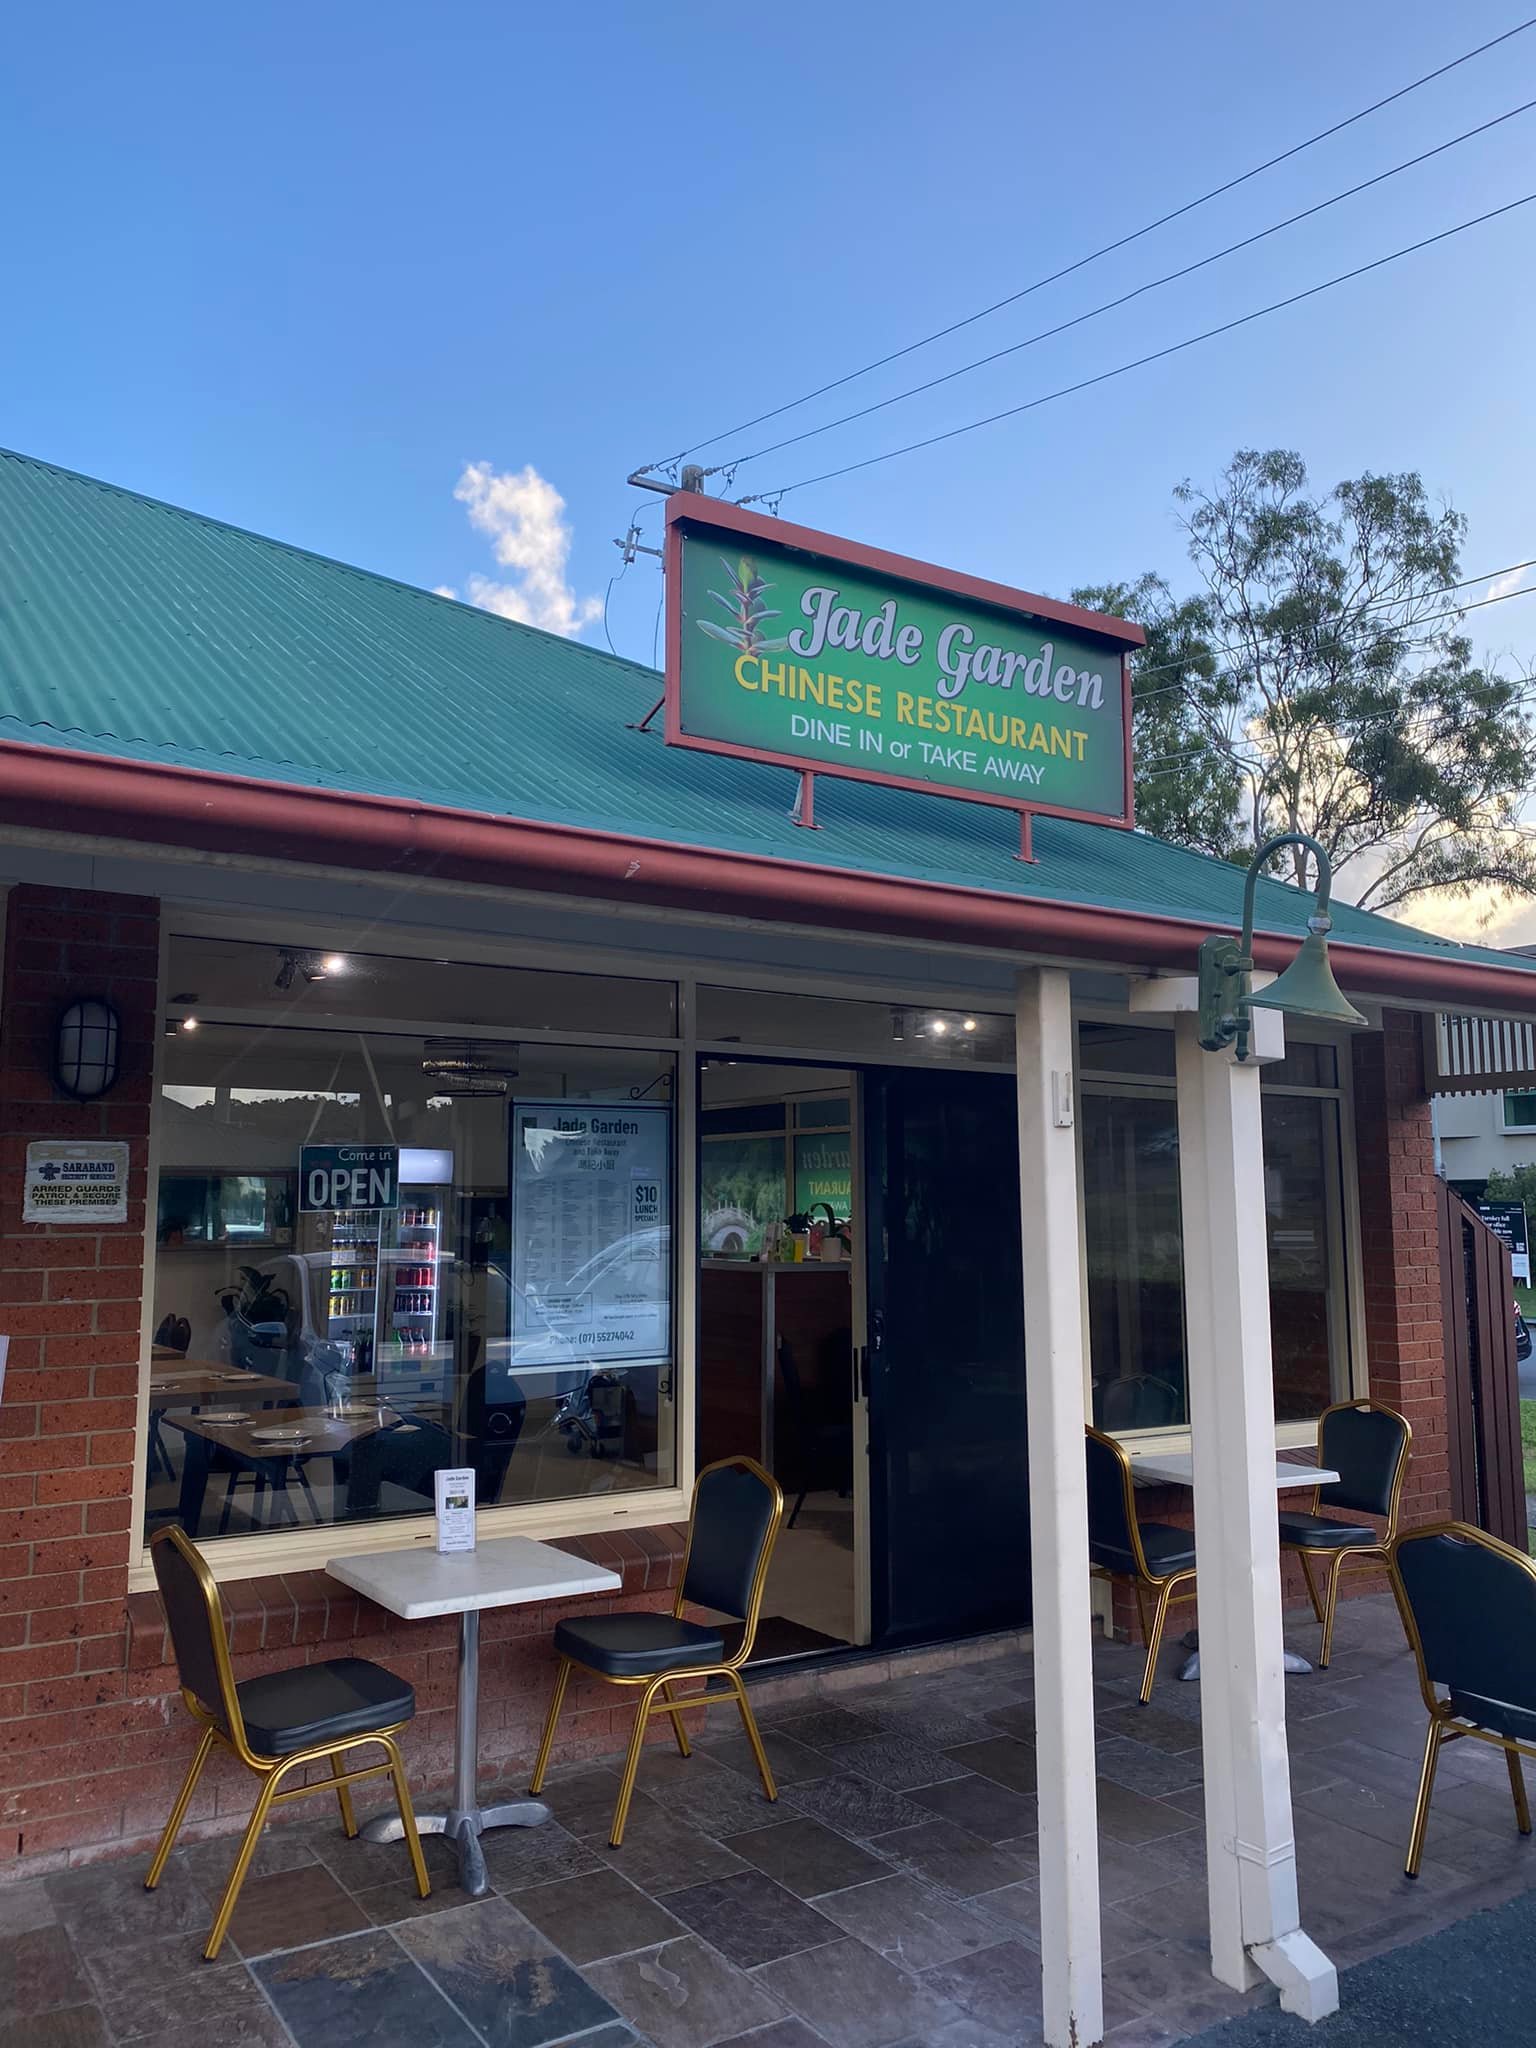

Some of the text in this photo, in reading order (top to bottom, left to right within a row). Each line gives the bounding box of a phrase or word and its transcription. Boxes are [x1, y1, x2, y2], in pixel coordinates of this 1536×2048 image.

[787, 586, 1104, 710] Jade Garden
[733, 654, 1088, 761] CHINESE RESTAURANT
[791, 714, 1046, 785] DINE IN or TAKE AWAY
[591, 1118, 638, 1135] Garden
[338, 1148, 392, 1161] Come in
[62, 1162, 115, 1173] SARABAND
[308, 1167, 391, 1207] OPEN
[635, 1185, 657, 1203] $10
[635, 1205, 658, 1214] LUNCH
[579, 1333, 596, 1345] (07)
[597, 1331, 635, 1343] 55274042
